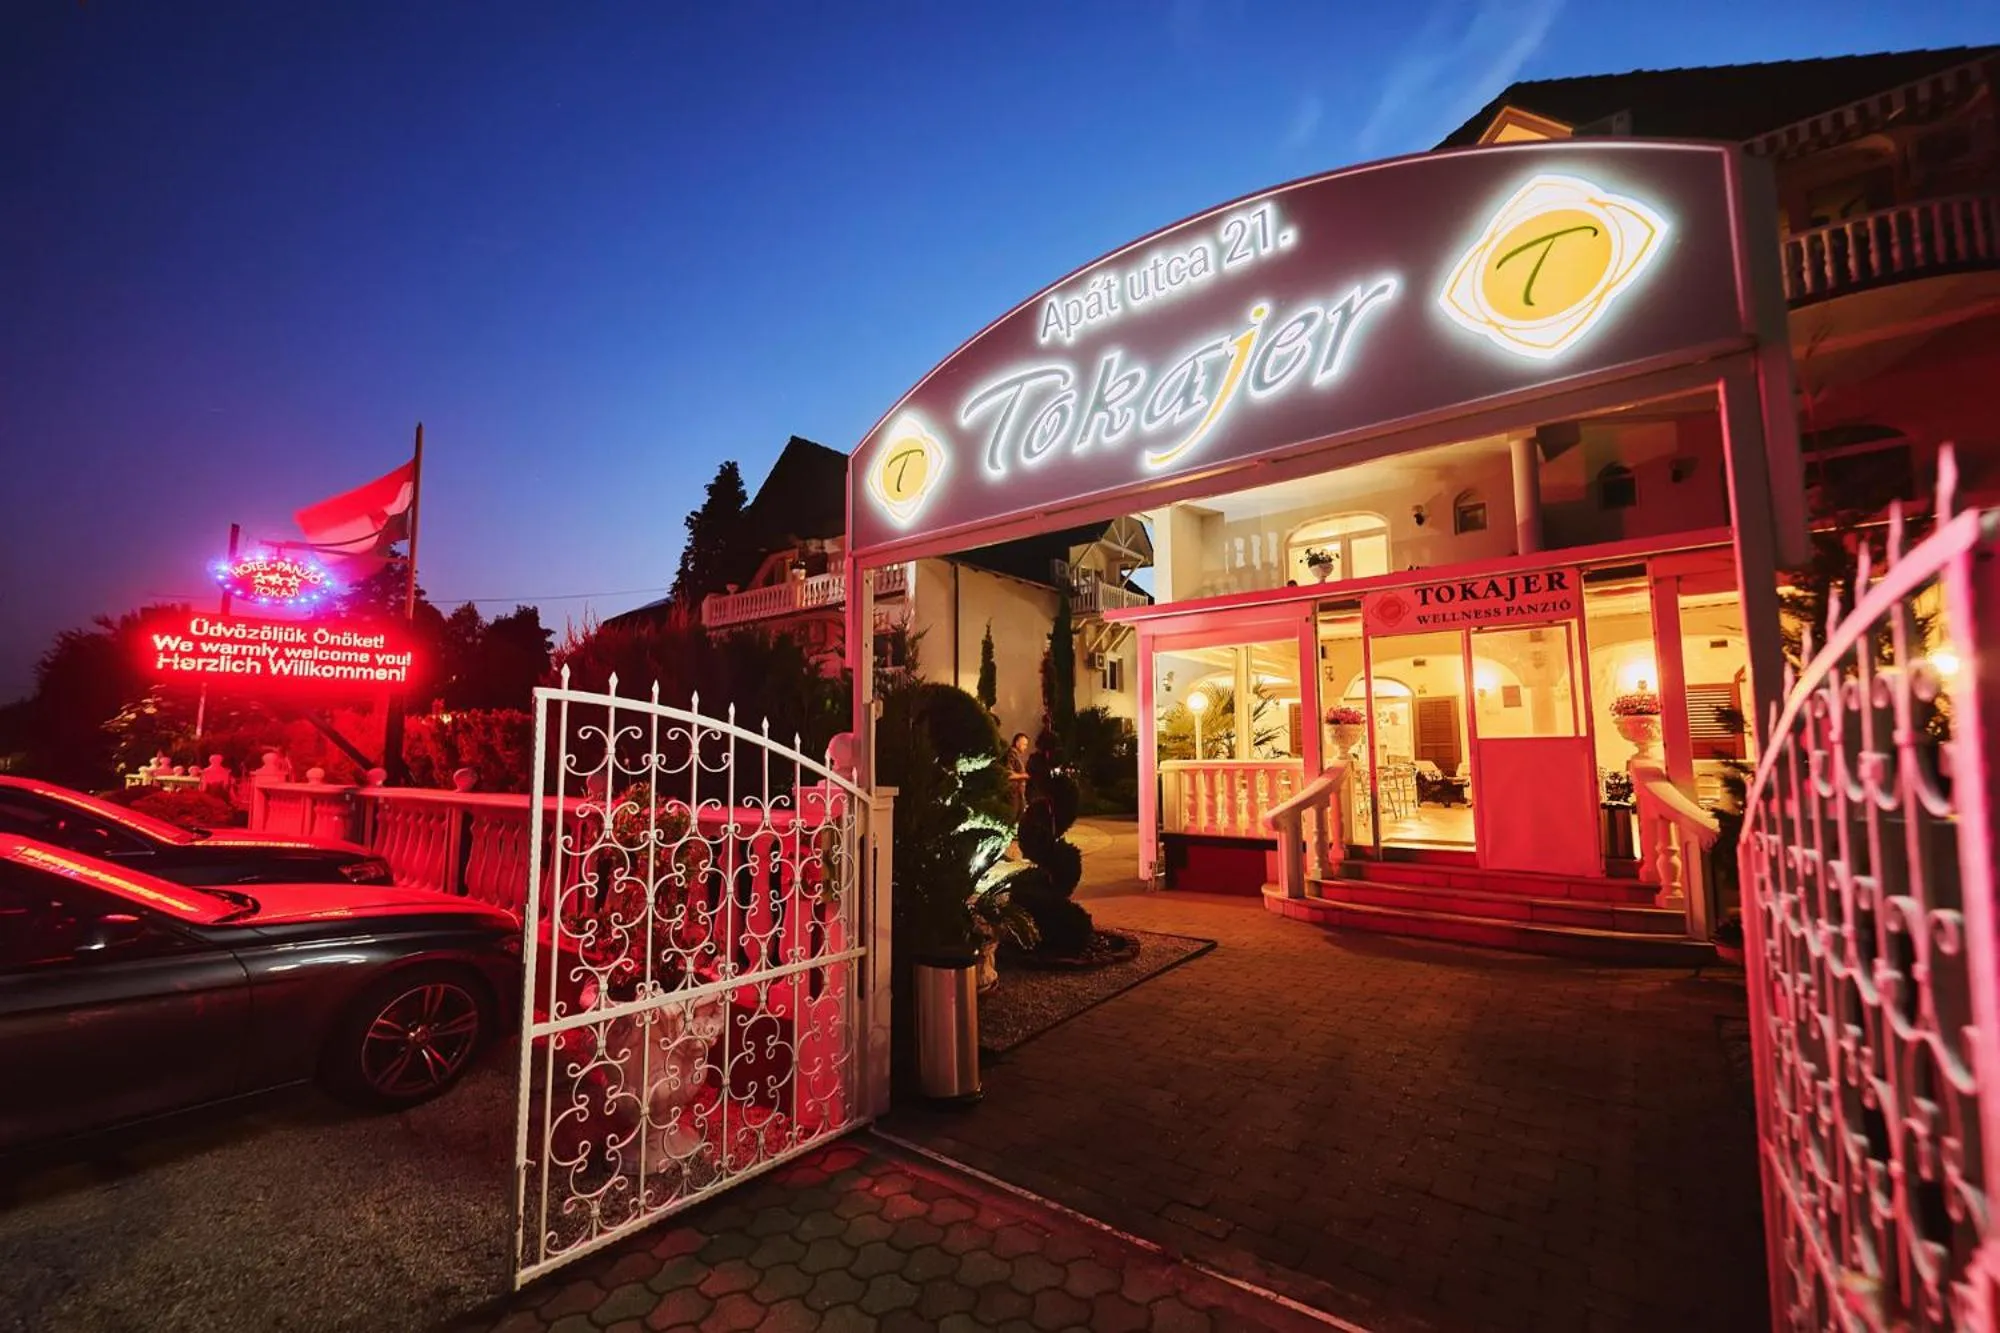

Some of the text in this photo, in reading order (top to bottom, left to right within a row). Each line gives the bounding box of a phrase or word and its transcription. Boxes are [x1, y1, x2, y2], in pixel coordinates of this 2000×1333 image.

[1041, 206, 1292, 341] Apát utca 21.
[961, 279, 1398, 470] Tokajer
[1414, 571, 1569, 606] TOKAJER
[1416, 598, 1572, 625] WELLNESS PANZIÓ
[152, 634, 412, 666] We warmly welcome you!
[313, 627, 385, 649] Önöket!
[156, 652, 406, 682] Herzlich Willkommen!
